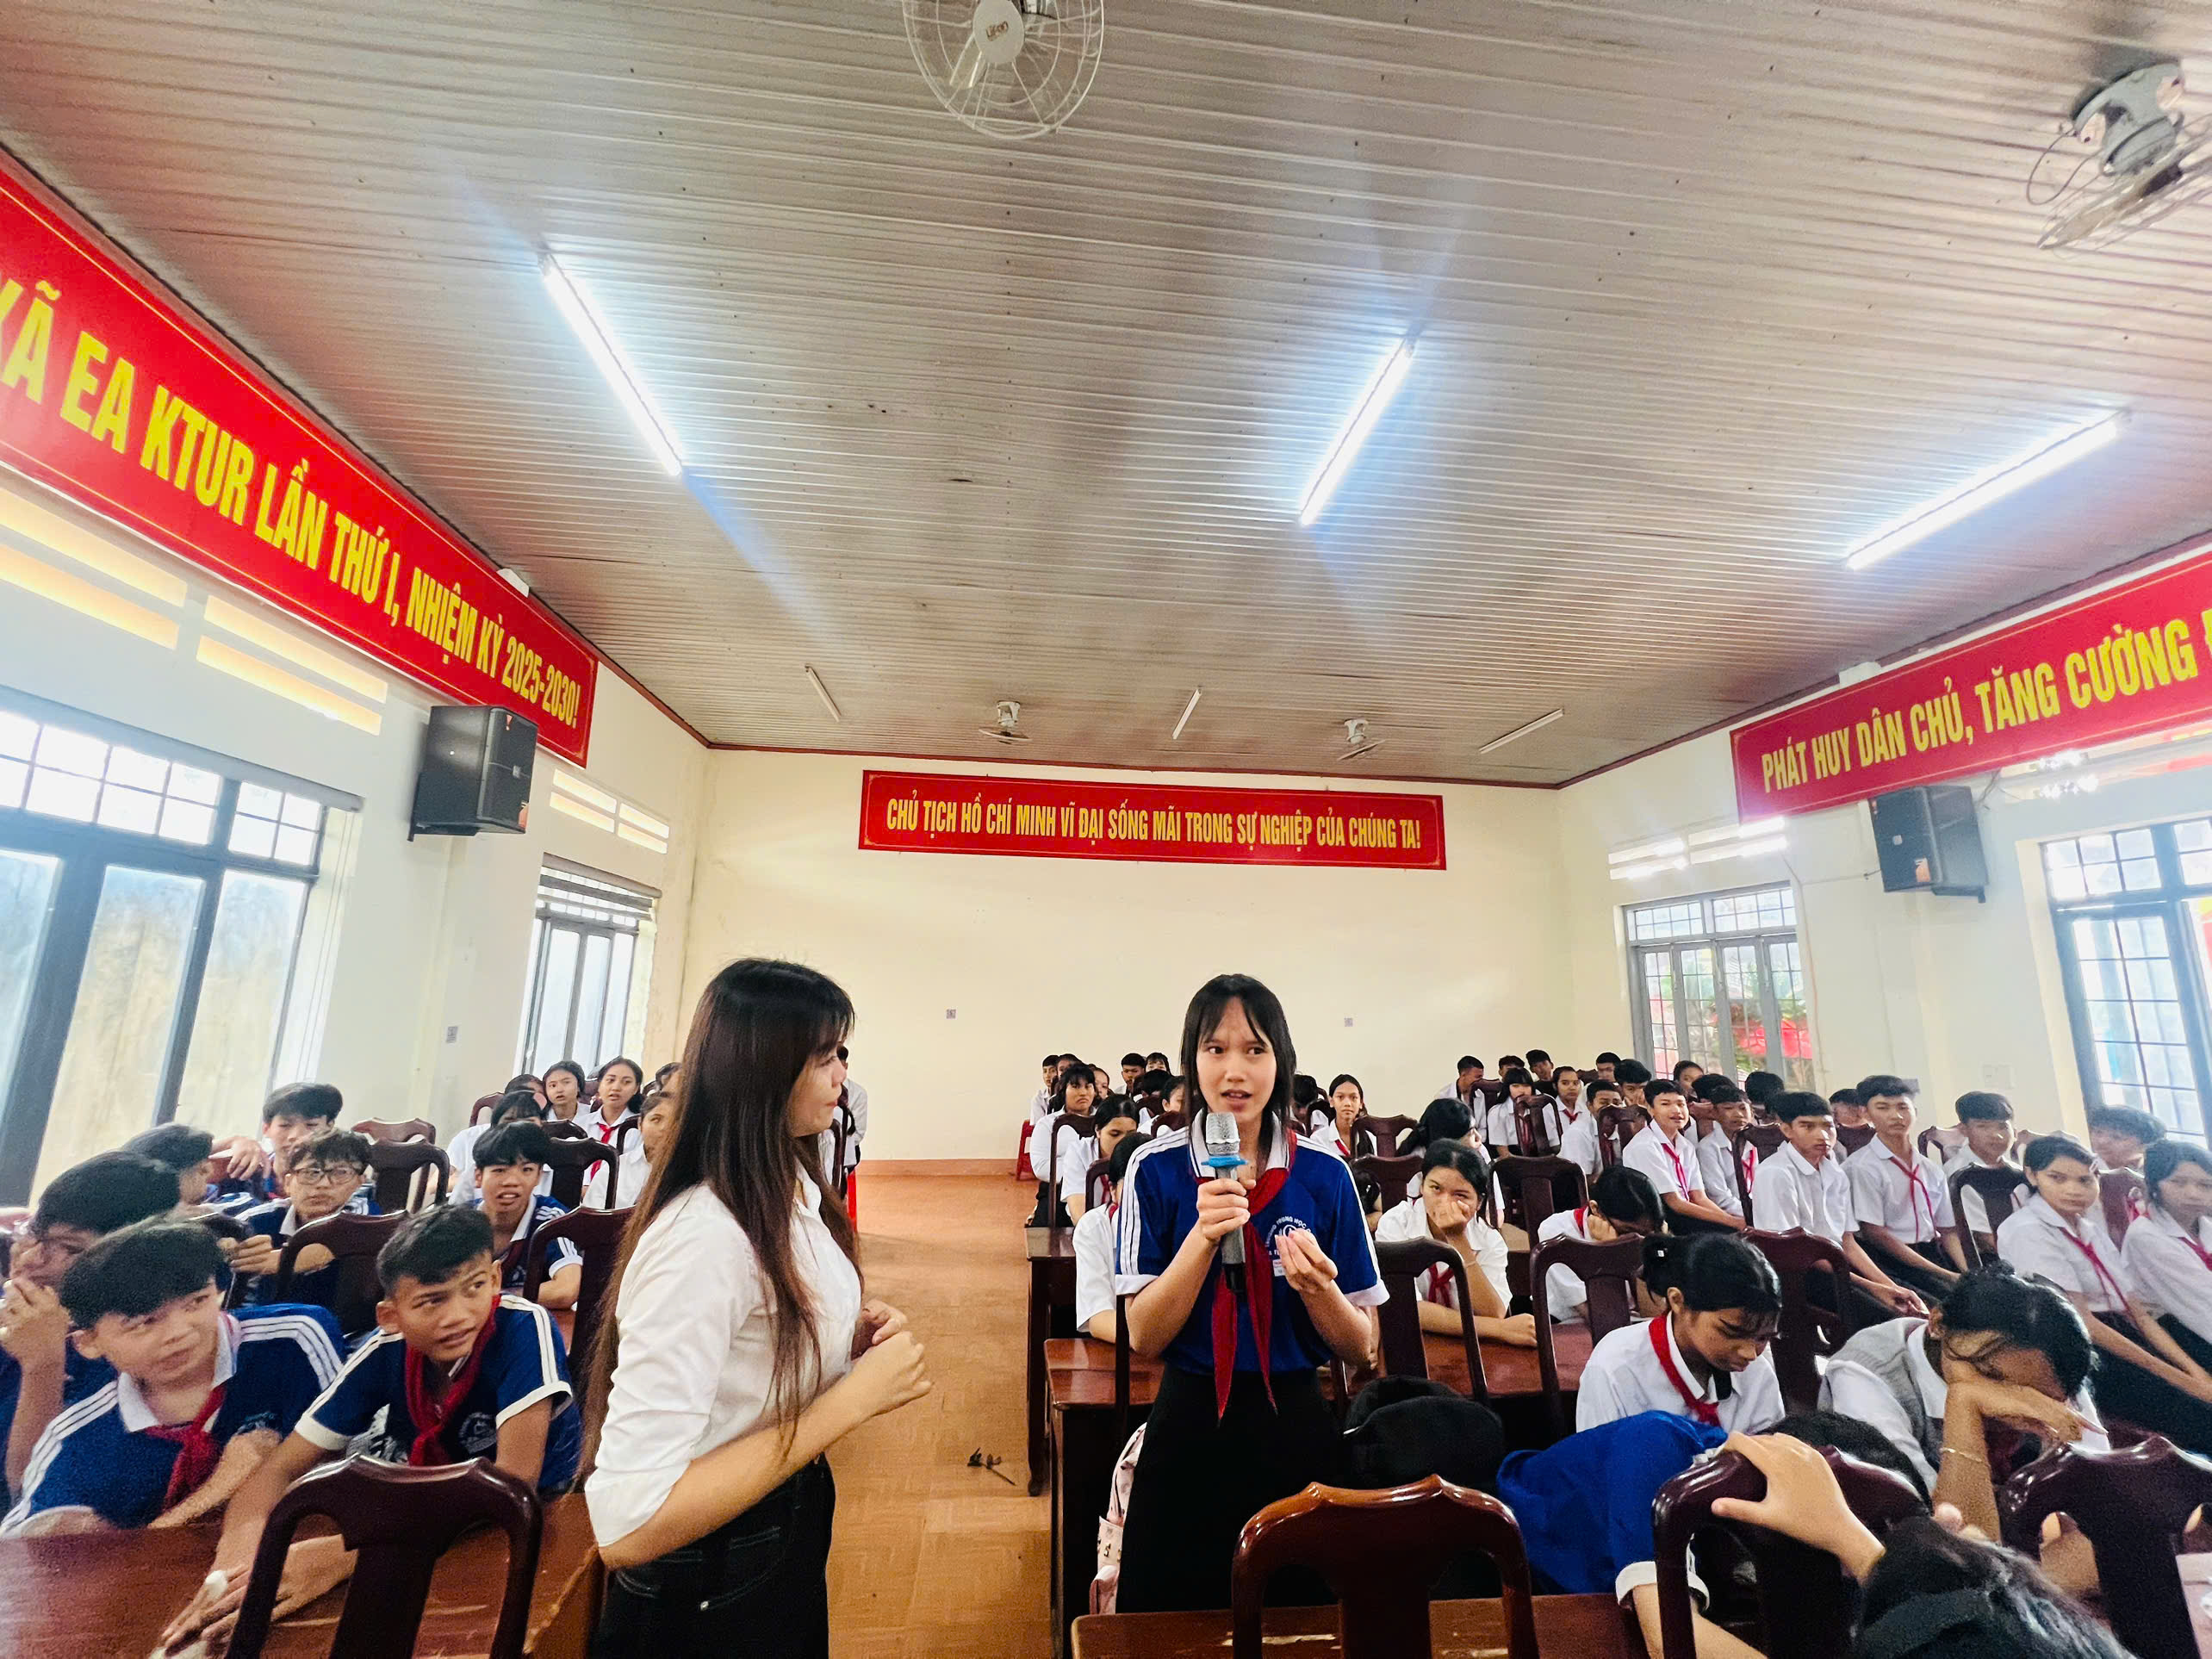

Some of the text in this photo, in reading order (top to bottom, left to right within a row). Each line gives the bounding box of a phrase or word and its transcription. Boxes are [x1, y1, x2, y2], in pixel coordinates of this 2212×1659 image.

[59, 330, 135, 455] EA
[140, 384, 254, 526] KTUR
[255, 457, 328, 571] LẦN
[329, 511, 390, 604] THỨ
[383, 551, 401, 627] I,
[405, 567, 478, 664] NHIỆM
[476, 613, 505, 679] KỲ
[501, 636, 581, 729] 2025-2030!
[1762, 736, 1808, 793] PHÁT
[1811, 727, 1851, 780] HUY
[1856, 707, 1907, 767] DÂN
[1910, 676, 1974, 752] CHỦ,
[1974, 662, 2060, 733] TĂNG
[2065, 618, 2198, 709] CƯỜNG
[887, 789, 1421, 852] CHỦ TỊCH HỒ CHÍ MINH VĨ ĐẠI SỐNG MÃI TRONG SỰ NGHIỆP CỦA CHÚNG TA!
